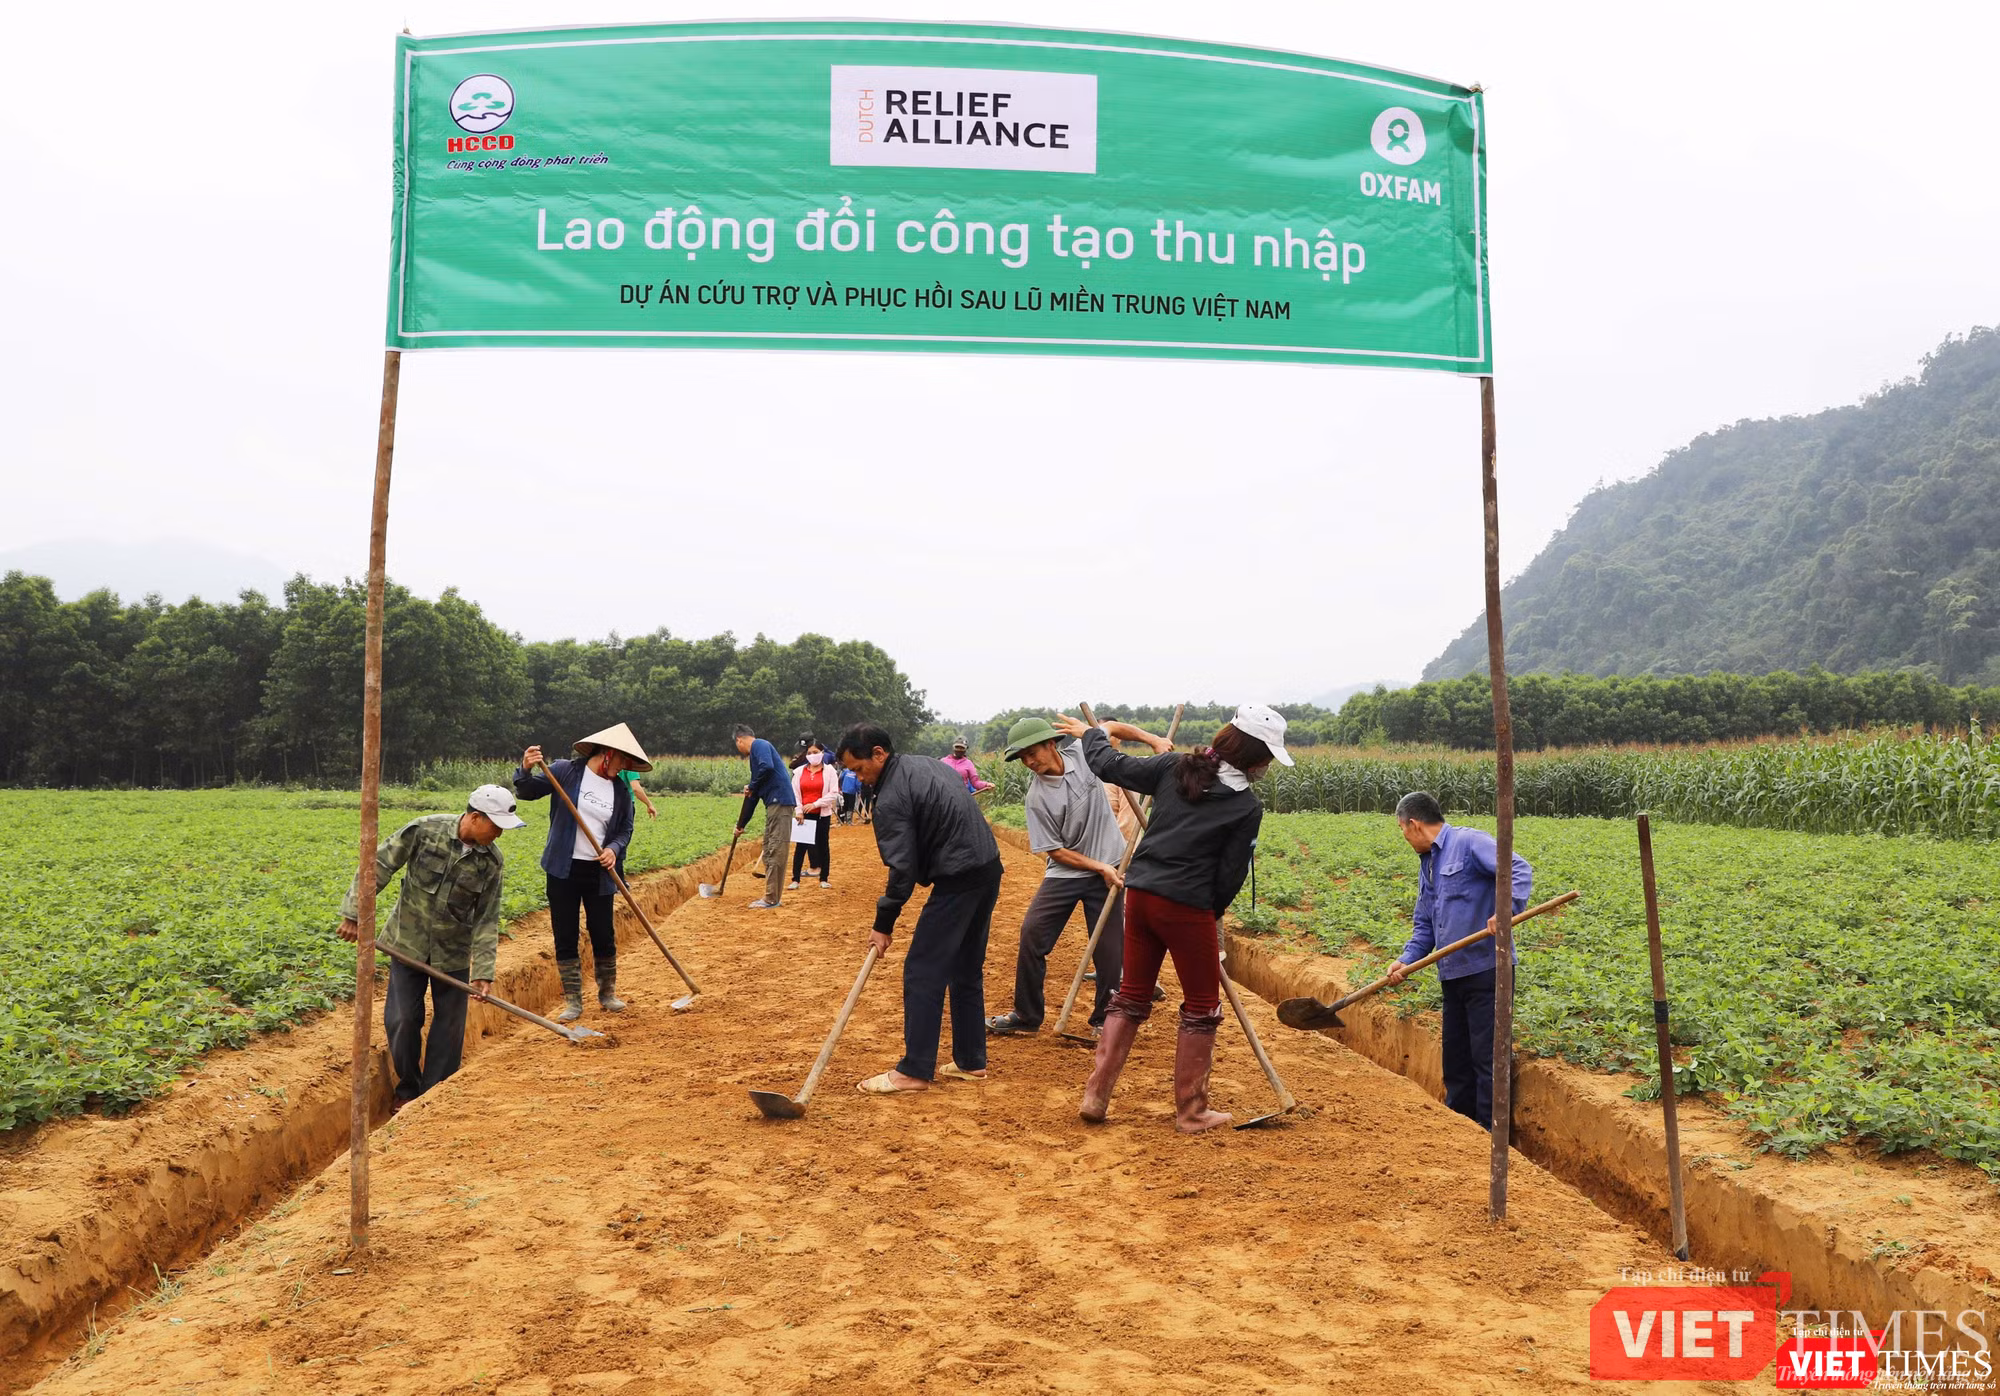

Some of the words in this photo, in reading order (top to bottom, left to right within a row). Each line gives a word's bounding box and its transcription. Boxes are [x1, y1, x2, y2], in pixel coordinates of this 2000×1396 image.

[858, 89, 874, 143] DUTCH
[886, 90, 1011, 117] RELIEF
[448, 135, 514, 152] HCCD
[883, 118, 1069, 149] ALLIANCE
[1360, 171, 1441, 205] OXFAM
[537, 208, 625, 252] Lao
[644, 205, 776, 263] động
[796, 195, 876, 253] đổi
[896, 208, 1029, 268] công
[1047, 214, 1135, 269] tạo
[1151, 219, 1235, 265] thu
[1253, 227, 1366, 284] nhập
[620, 284, 653, 308] DỰ
[659, 279, 690, 304] ÁN
[697, 279, 745, 305] CỨU
[752, 285, 800, 310] TRỢ
[806, 280, 838, 306] VÀ
[845, 287, 907, 312] PHỤC
[915, 280, 953, 309] HỒI
[960, 289, 1006, 310] SAU
[1014, 286, 1042, 311] LŨ
[1050, 284, 1105, 313] MIỀN
[1112, 293, 1185, 316] TRUNG
[1193, 292, 1239, 322] VIỆT
[1246, 299, 1291, 320] NAM
